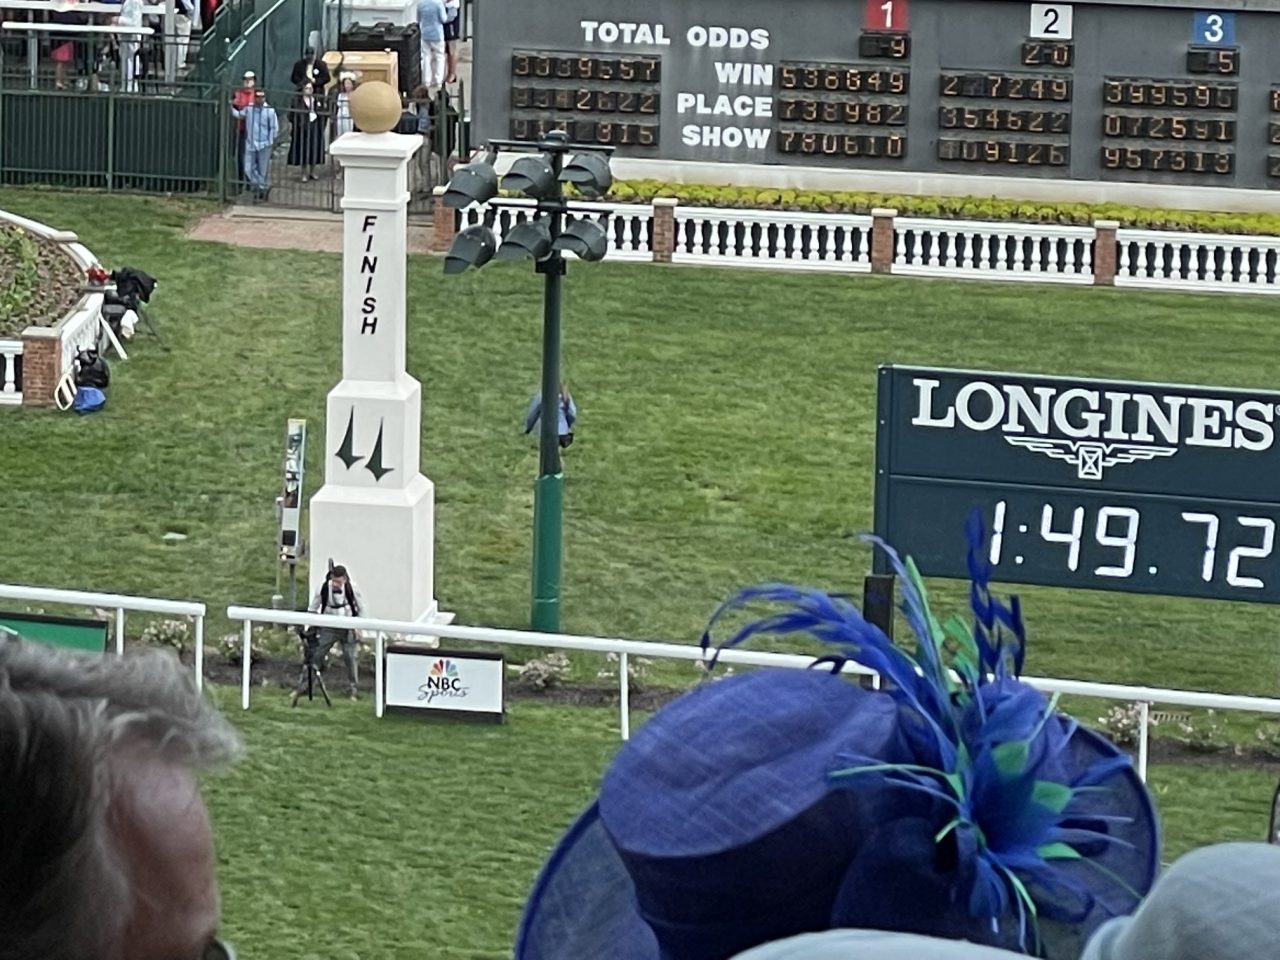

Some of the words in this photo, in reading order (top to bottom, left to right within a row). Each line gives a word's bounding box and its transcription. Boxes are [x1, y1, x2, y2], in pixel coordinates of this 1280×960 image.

[881, 1, 893, 28] 1
[1043, 8, 1059, 34] 2
[581, 20, 670, 45] TOTAL
[687, 26, 770, 49] ODDS
[1204, 14, 1224, 42] 3
[715, 62, 774, 86] WIN
[677, 93, 773, 117] PLACE
[682, 124, 771, 149] SHOW
[361, 216, 378, 335] FINISH
[911, 378, 1274, 451] LONGINES
[417, 683, 470, 704] Sports
[427, 676, 461, 692] NBC
